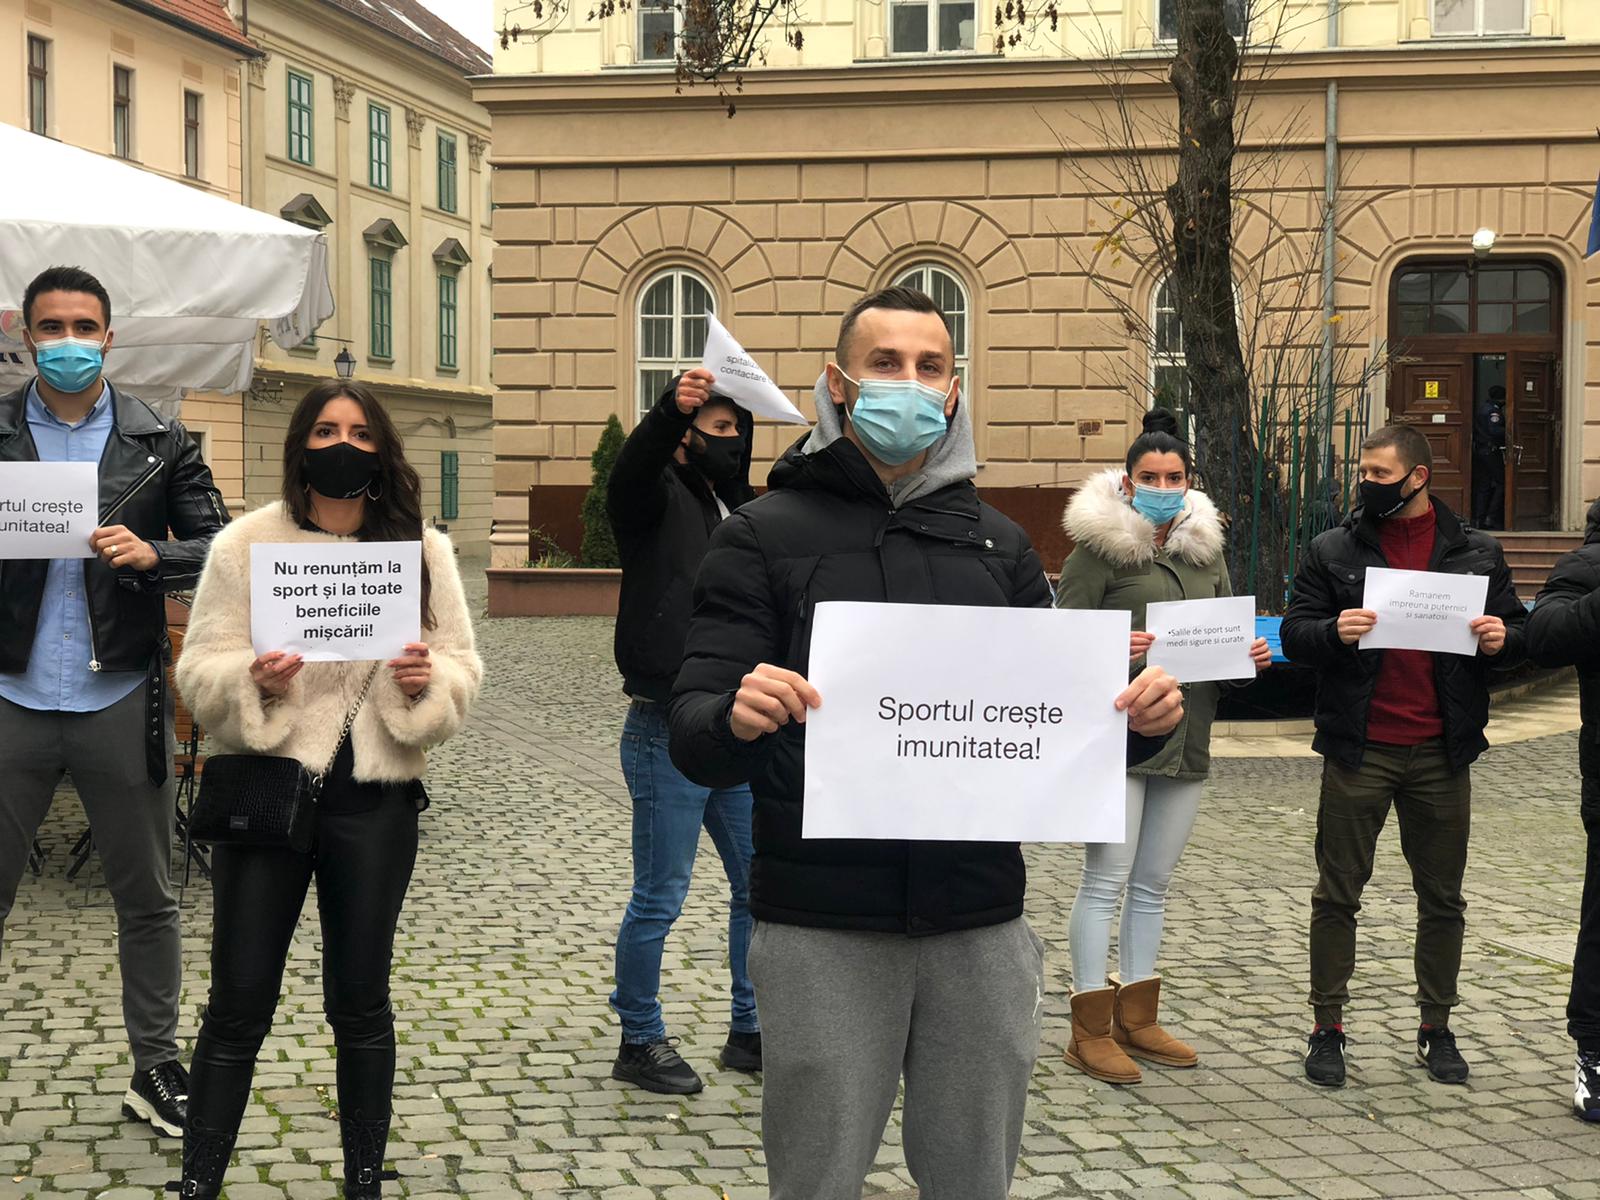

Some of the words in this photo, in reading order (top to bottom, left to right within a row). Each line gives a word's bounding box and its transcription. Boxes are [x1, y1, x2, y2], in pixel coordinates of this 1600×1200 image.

[720, 366, 767, 382] contactare
[32, 501, 83, 516] crește
[274, 561, 298, 575] Nu
[303, 560, 383, 577] renunțăm
[388, 560, 402, 574] la
[272, 584, 318, 599] sport
[323, 583, 337, 599] și
[342, 582, 356, 596] la
[361, 582, 403, 595] toate
[1408, 588, 1451, 600] Ramanem
[296, 603, 381, 618] beneficiile
[1389, 599, 1429, 610] impreuna
[1431, 602, 1468, 612] puternici
[303, 624, 374, 641] mișcării!
[1192, 626, 1202, 635] de
[1203, 626, 1223, 636] sport
[1224, 625, 1241, 633] sunt
[1166, 639, 1188, 647] medii
[1189, 638, 1212, 648] sigure
[1221, 635, 1245, 644] curate
[878, 696, 974, 726] Sportul
[983, 702, 1063, 729] crește
[897, 734, 1041, 760] imunitatea!
